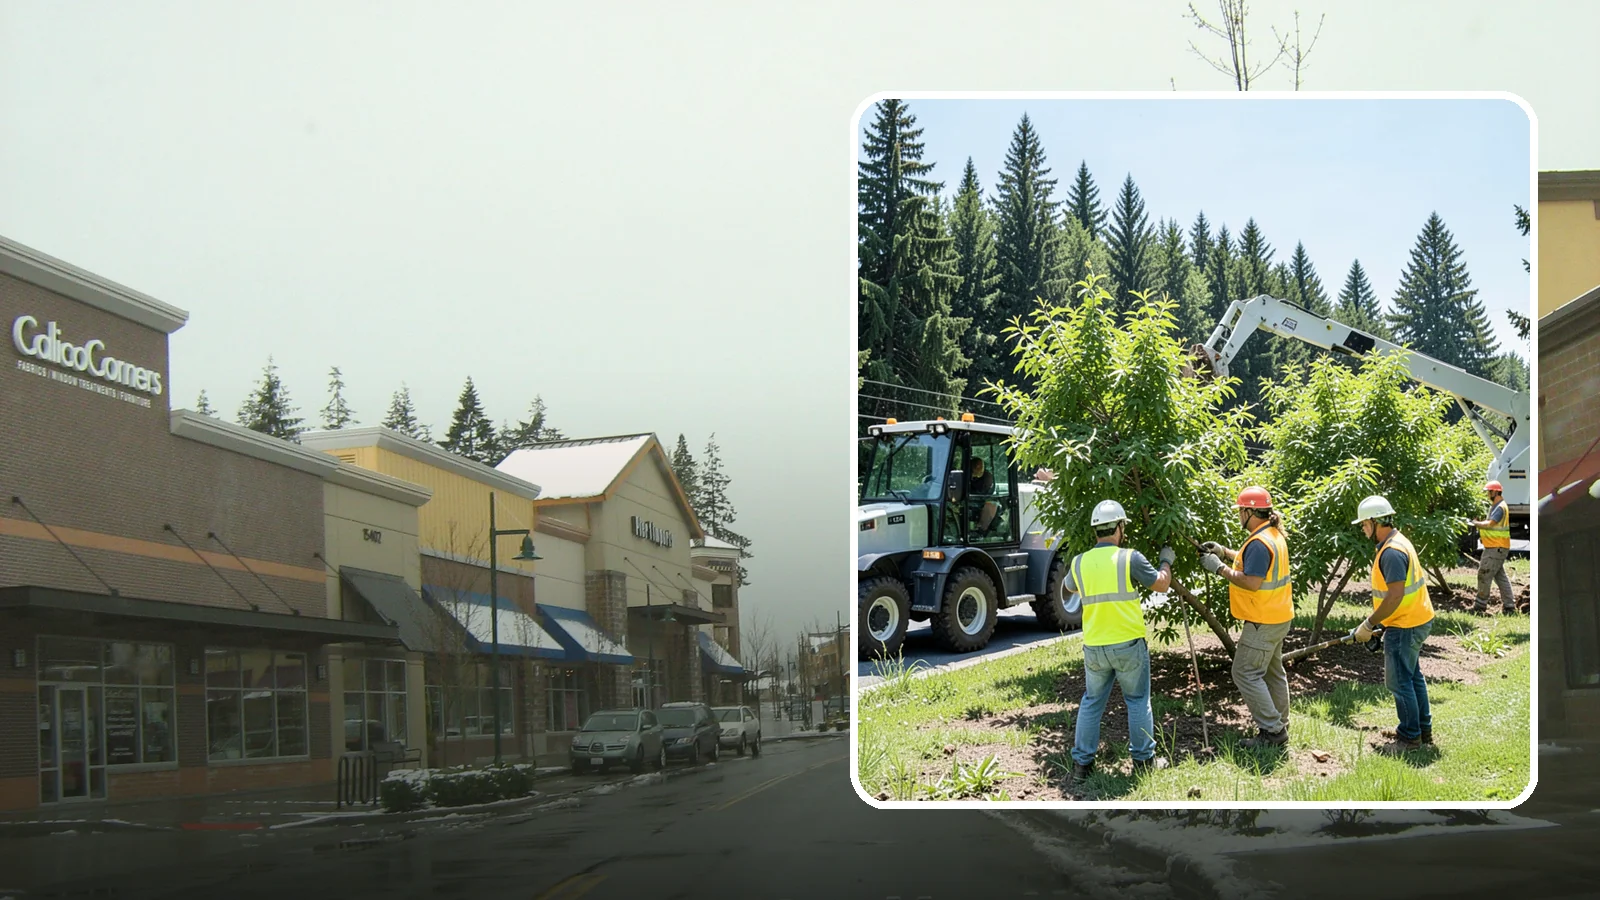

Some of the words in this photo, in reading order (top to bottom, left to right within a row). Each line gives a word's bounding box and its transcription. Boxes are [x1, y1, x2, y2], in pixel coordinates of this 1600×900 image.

[16, 360, 47, 378] FABRICS
[51, 370, 77, 387] WINDOW
[79, 379, 116, 399] TREATMENTS
